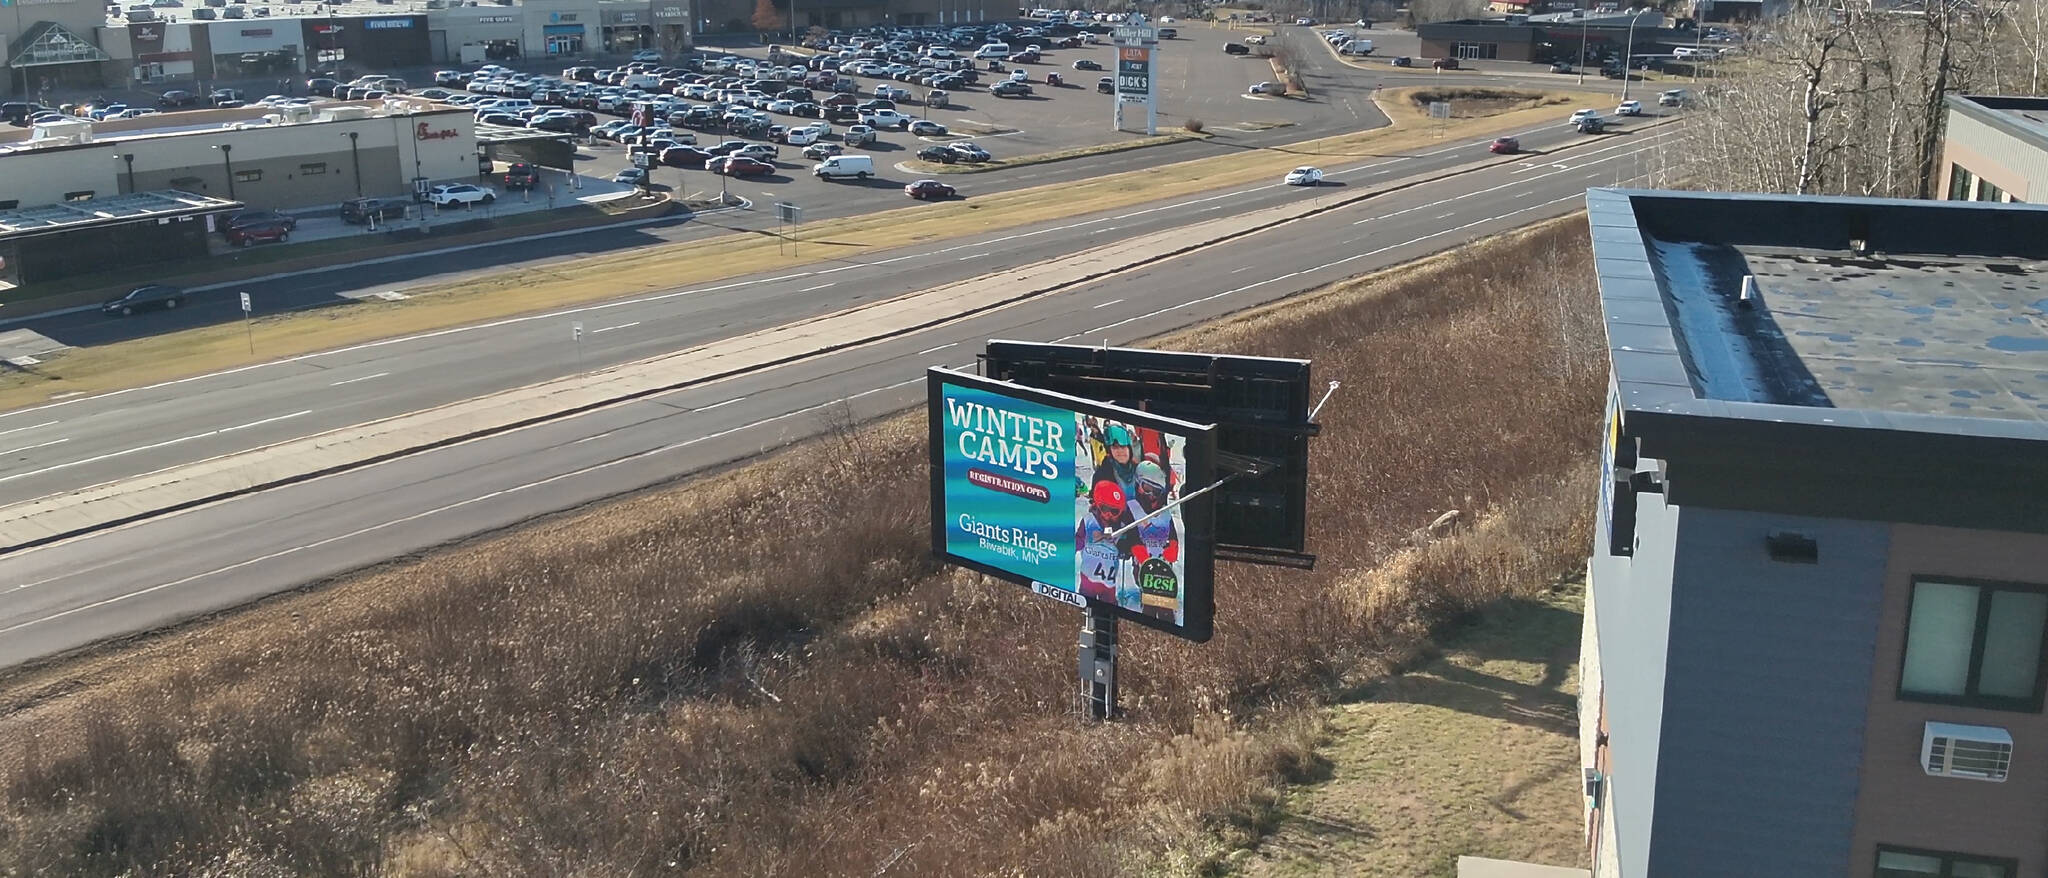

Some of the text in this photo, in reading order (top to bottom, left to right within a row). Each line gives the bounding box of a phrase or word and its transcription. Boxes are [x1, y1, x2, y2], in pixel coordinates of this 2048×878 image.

[1115, 27, 1152, 38] Miller Hill
[1124, 38, 1142, 46] Mall
[1126, 48, 1142, 57] ULTA
[1119, 75, 1147, 88] DICK'S
[947, 398, 1065, 452] WINTER
[959, 431, 1059, 480] CAMPS
[969, 470, 1047, 499] REGISTRATION OPEN
[959, 513, 1057, 559] Giants Ridge
[979, 537, 1040, 565] Biwabik, MN
[1094, 562, 1116, 584] 44
[1143, 573, 1176, 591] Best
